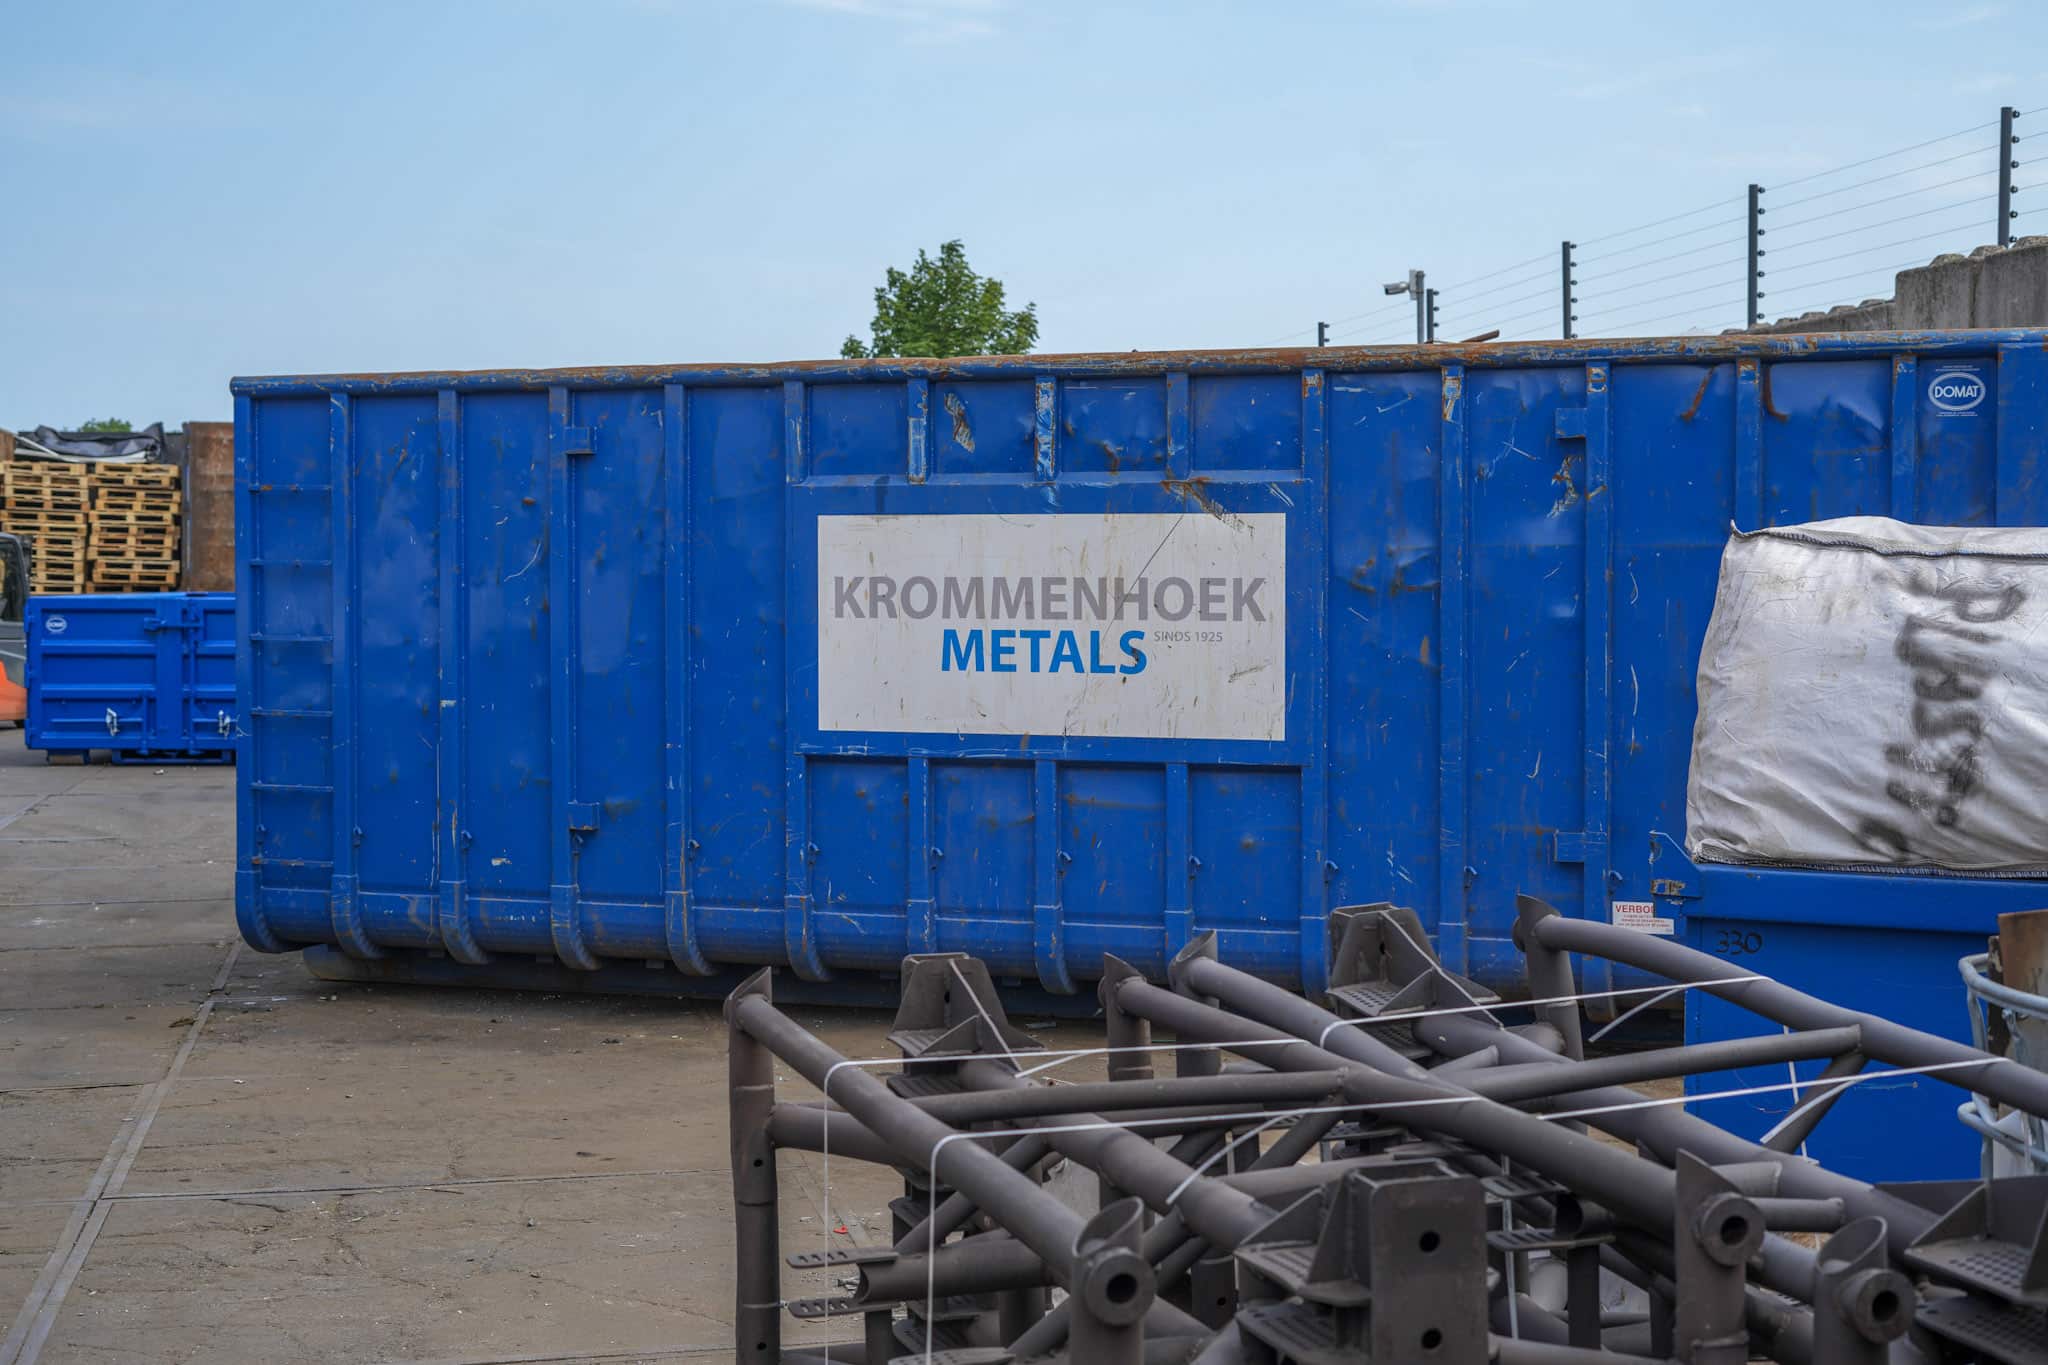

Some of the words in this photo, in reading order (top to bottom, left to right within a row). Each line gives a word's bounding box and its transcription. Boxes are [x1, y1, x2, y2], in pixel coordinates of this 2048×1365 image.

[1934, 385, 1979, 398] DOMAT
[834, 576, 1267, 621] KROMMENHOEK
[1153, 631, 1191, 642] SINDS
[1195, 632, 1223, 642] 1925
[941, 629, 1148, 675] METALS
[1716, 930, 1763, 955] 330
